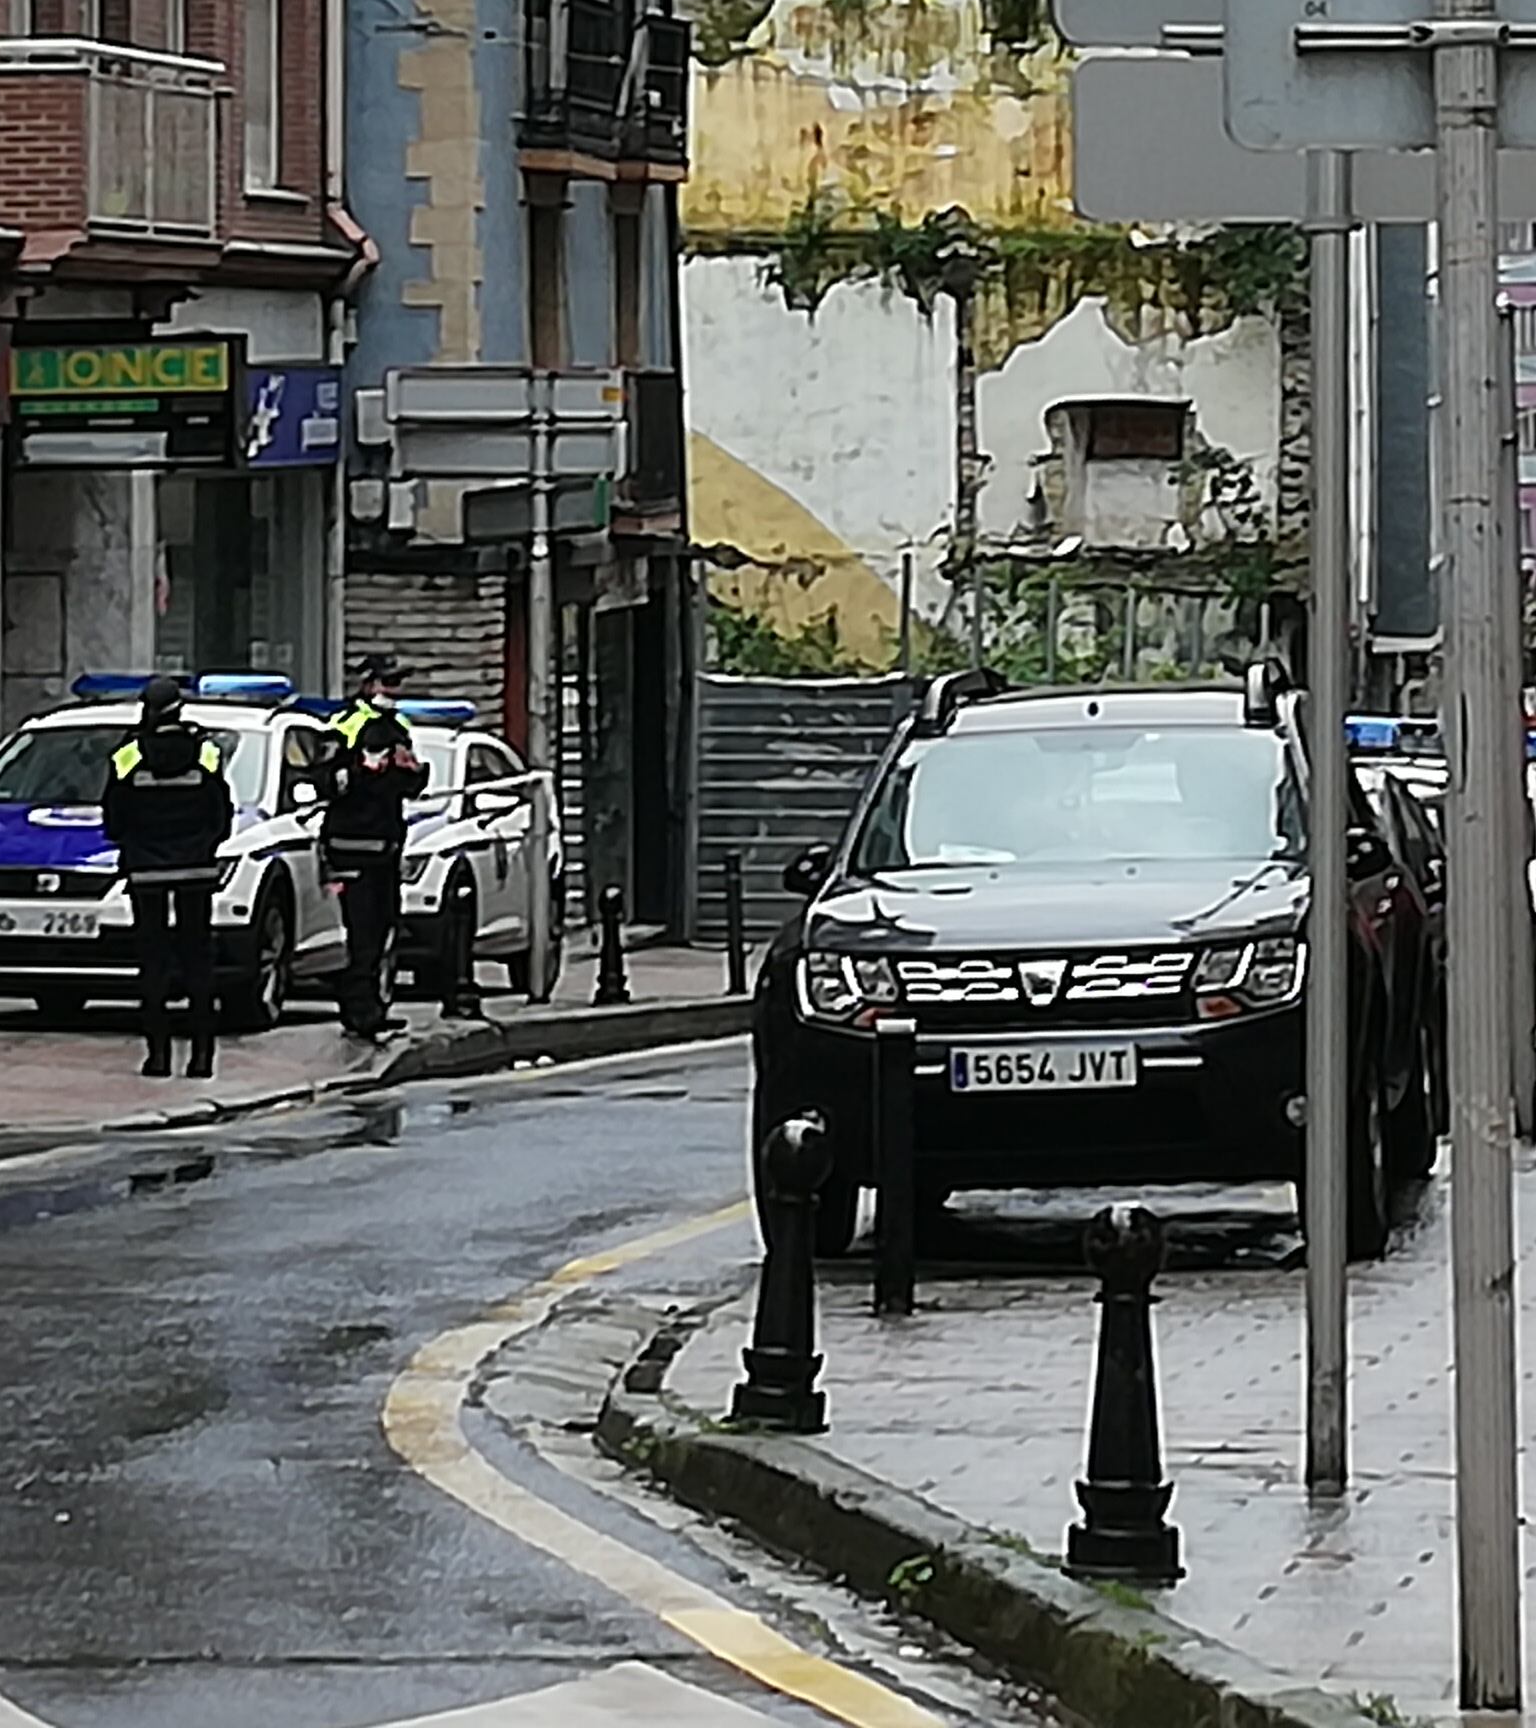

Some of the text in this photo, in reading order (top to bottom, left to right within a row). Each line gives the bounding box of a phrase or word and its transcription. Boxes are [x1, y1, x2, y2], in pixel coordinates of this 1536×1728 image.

[66, 349, 218, 387] ONCE
[974, 1051, 1128, 1085] 5654 JVT
